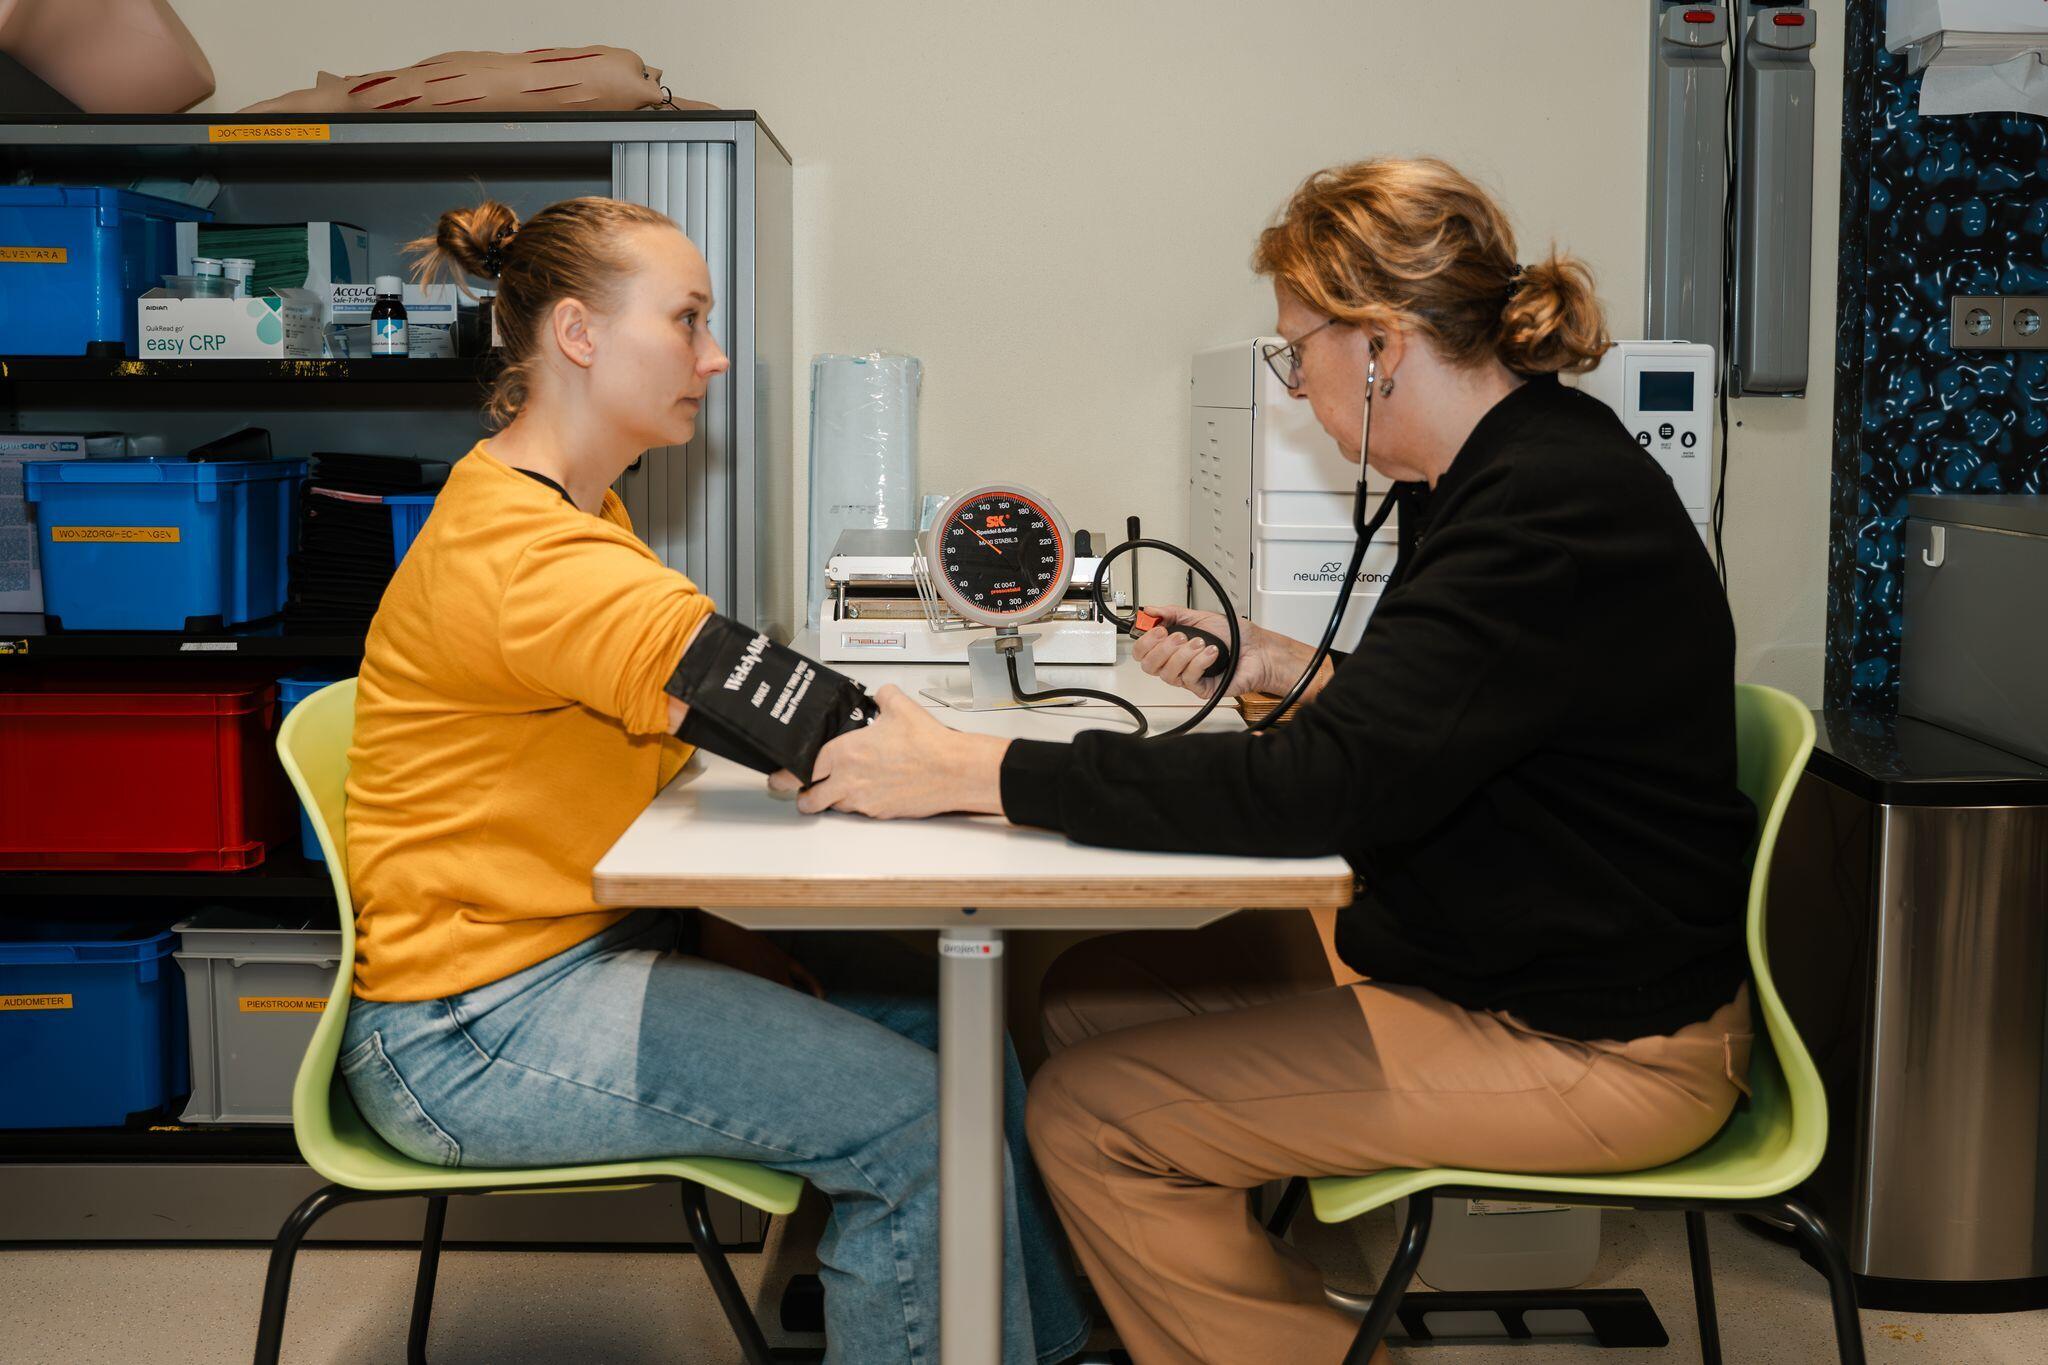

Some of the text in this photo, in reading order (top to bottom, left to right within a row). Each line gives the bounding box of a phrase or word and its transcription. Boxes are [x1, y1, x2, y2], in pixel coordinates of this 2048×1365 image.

[263, 127, 321, 136] ASSSTENTE
[146, 335, 226, 354] easy CRP
[59, 530, 172, 538] WONDZORG/HECHTNGEN
[1293, 572, 1346, 582] newmed
[4, 996, 64, 1006] AUDIOMETER
